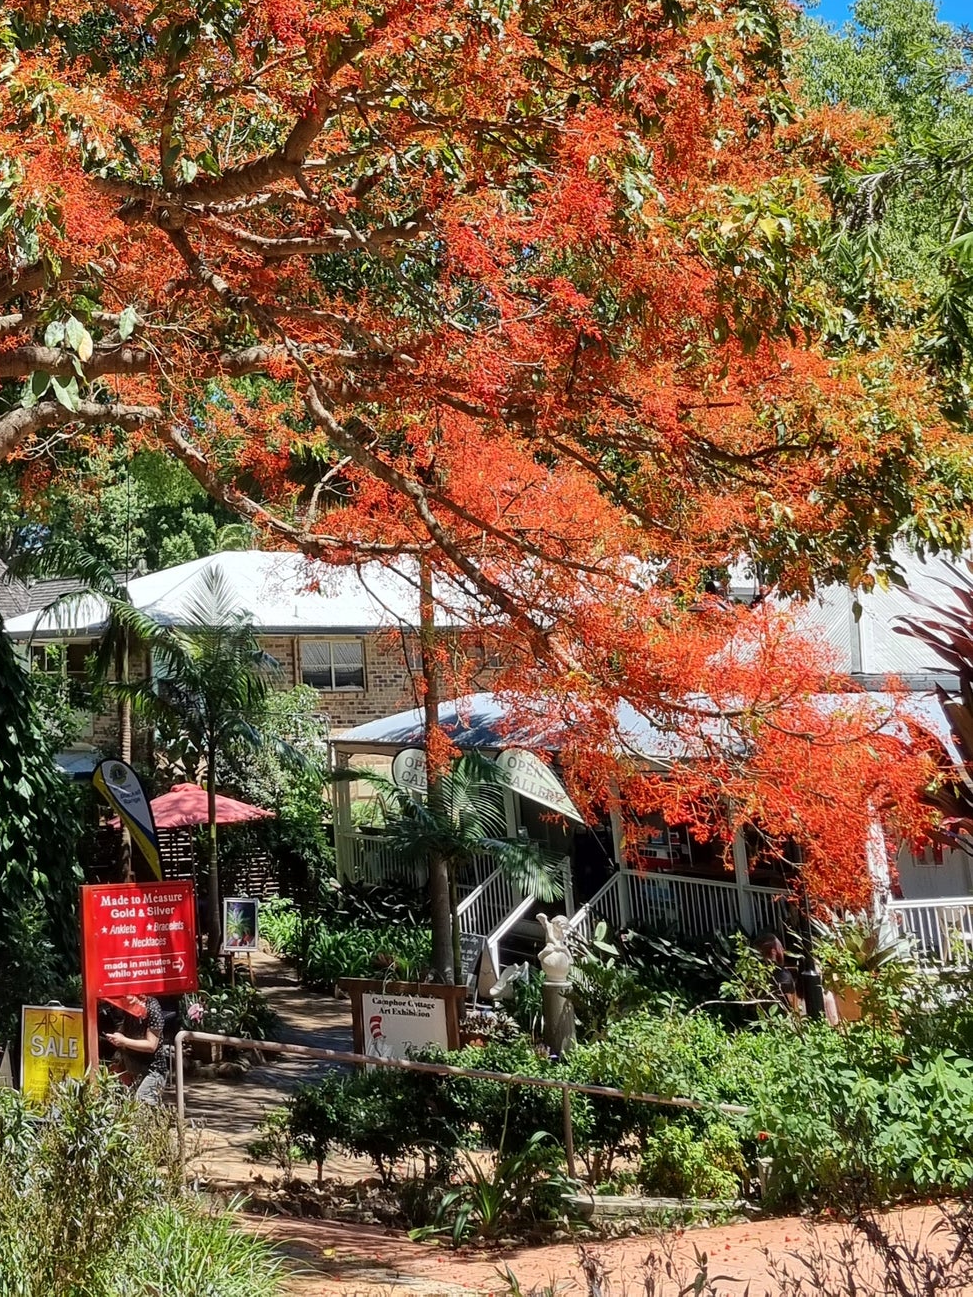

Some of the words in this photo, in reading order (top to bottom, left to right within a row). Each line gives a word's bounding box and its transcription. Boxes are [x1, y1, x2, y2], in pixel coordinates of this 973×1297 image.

[507, 756, 543, 780] OPEN
[100, 894, 129, 906] Made
[131, 896, 141, 904] to
[142, 893, 183, 904] Measure
[110, 908, 136, 918] Gold
[138, 908, 145, 917] &
[147, 906, 175, 916] Silver
[109, 924, 137, 935] Anklets
[154, 920, 184, 932] Bracelets
[132, 937, 167, 948] Necklaces
[104, 961, 128, 970] made
[130, 960, 138, 968] in
[139, 958, 171, 968] minutes
[108, 970, 131, 978] while
[132, 969, 148, 978] you
[150, 966, 166, 975] wait
[372, 997, 406, 1007] Camphor
[392, 1008, 430, 1018] Exhibiion
[32, 1013, 76, 1038] ART
[30, 1035, 78, 1060] SALE
